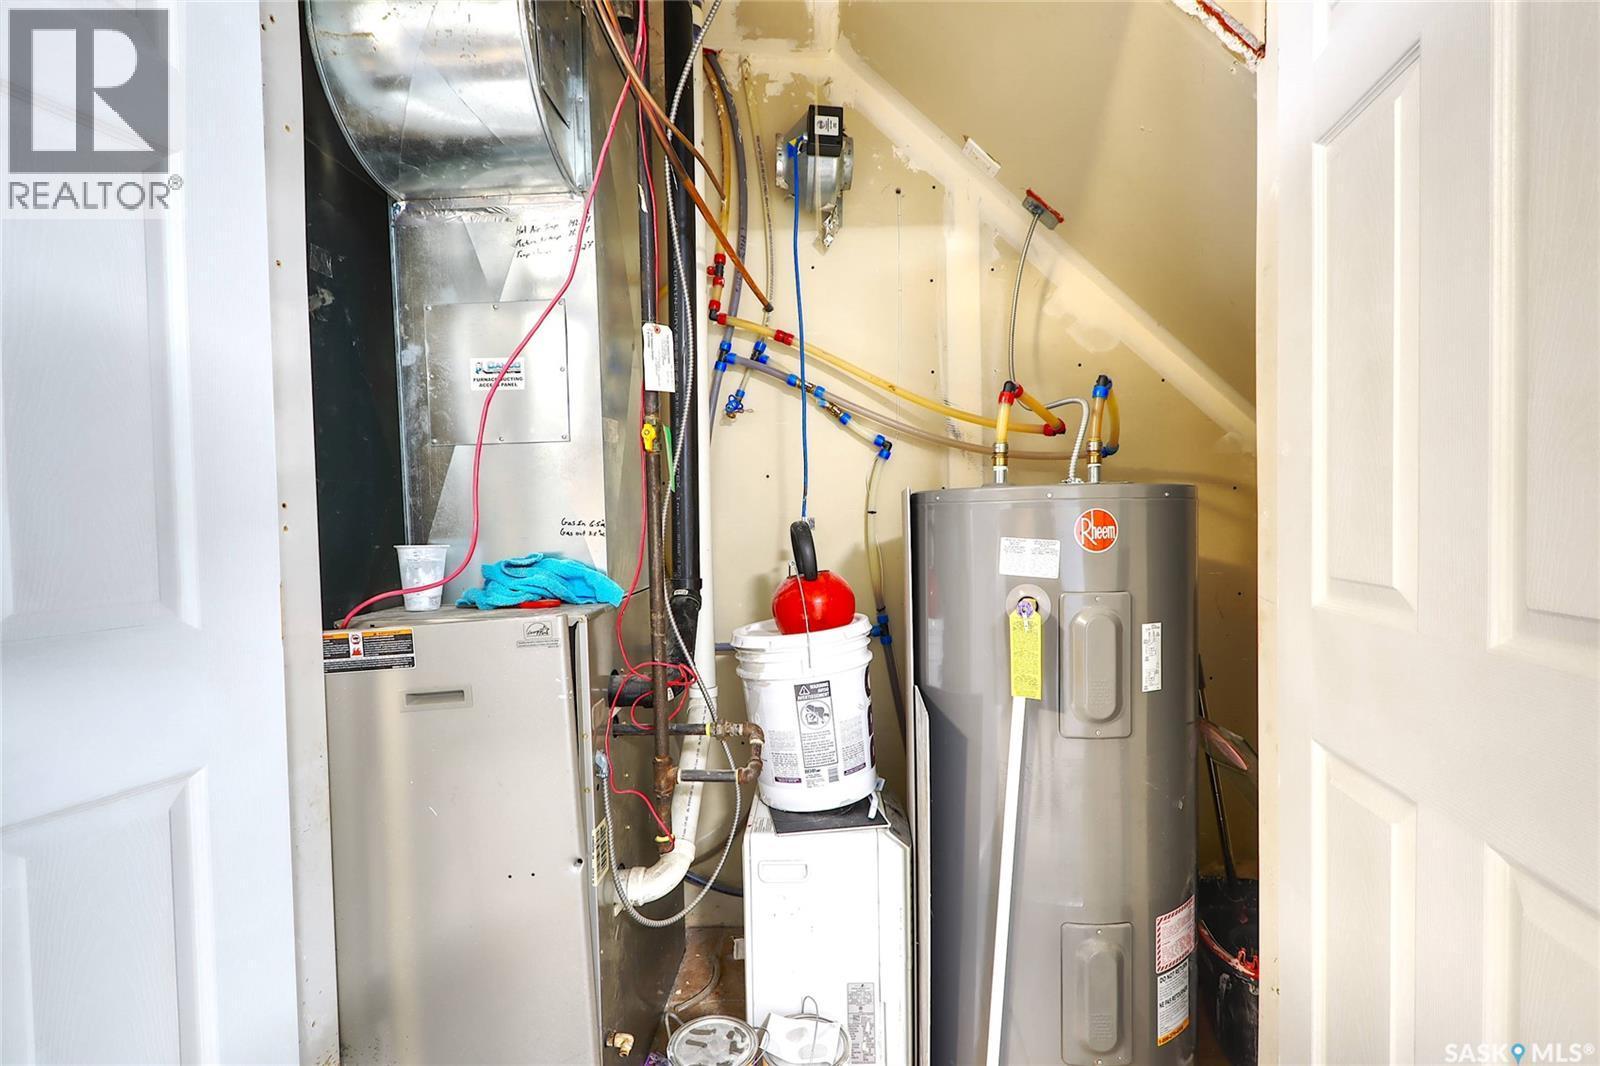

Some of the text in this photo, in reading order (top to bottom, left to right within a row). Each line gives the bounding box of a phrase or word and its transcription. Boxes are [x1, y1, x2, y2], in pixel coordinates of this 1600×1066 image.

[561, 517, 576, 526] Gas
[560, 527, 573, 536] Gas
[1080, 509, 1116, 546] Rheem
[1160, 976, 1167, 984] DO
